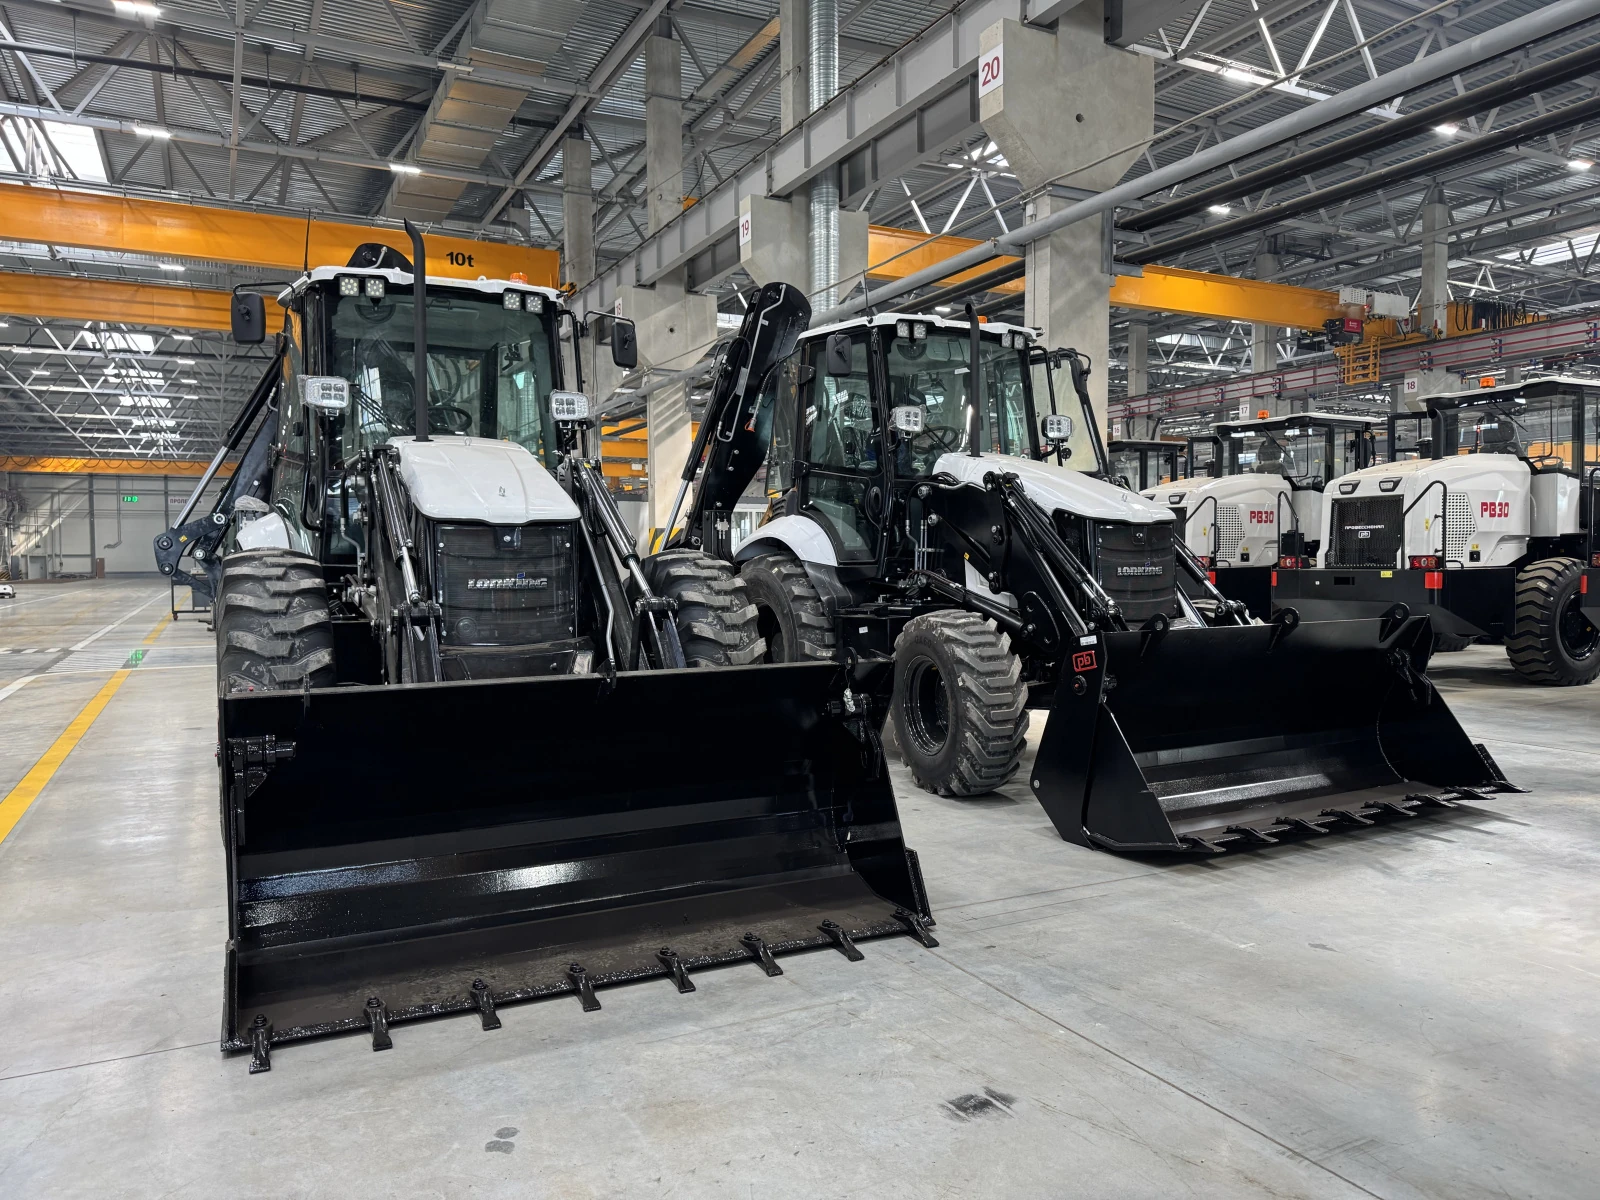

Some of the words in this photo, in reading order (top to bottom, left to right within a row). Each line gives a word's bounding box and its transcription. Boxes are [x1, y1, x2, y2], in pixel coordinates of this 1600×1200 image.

[981, 56, 1000, 87] 20
[741, 219, 750, 238] 19
[446, 251, 475, 267] 10t
[1406, 380, 1416, 390] 18
[1240, 406, 1248, 414] 17
